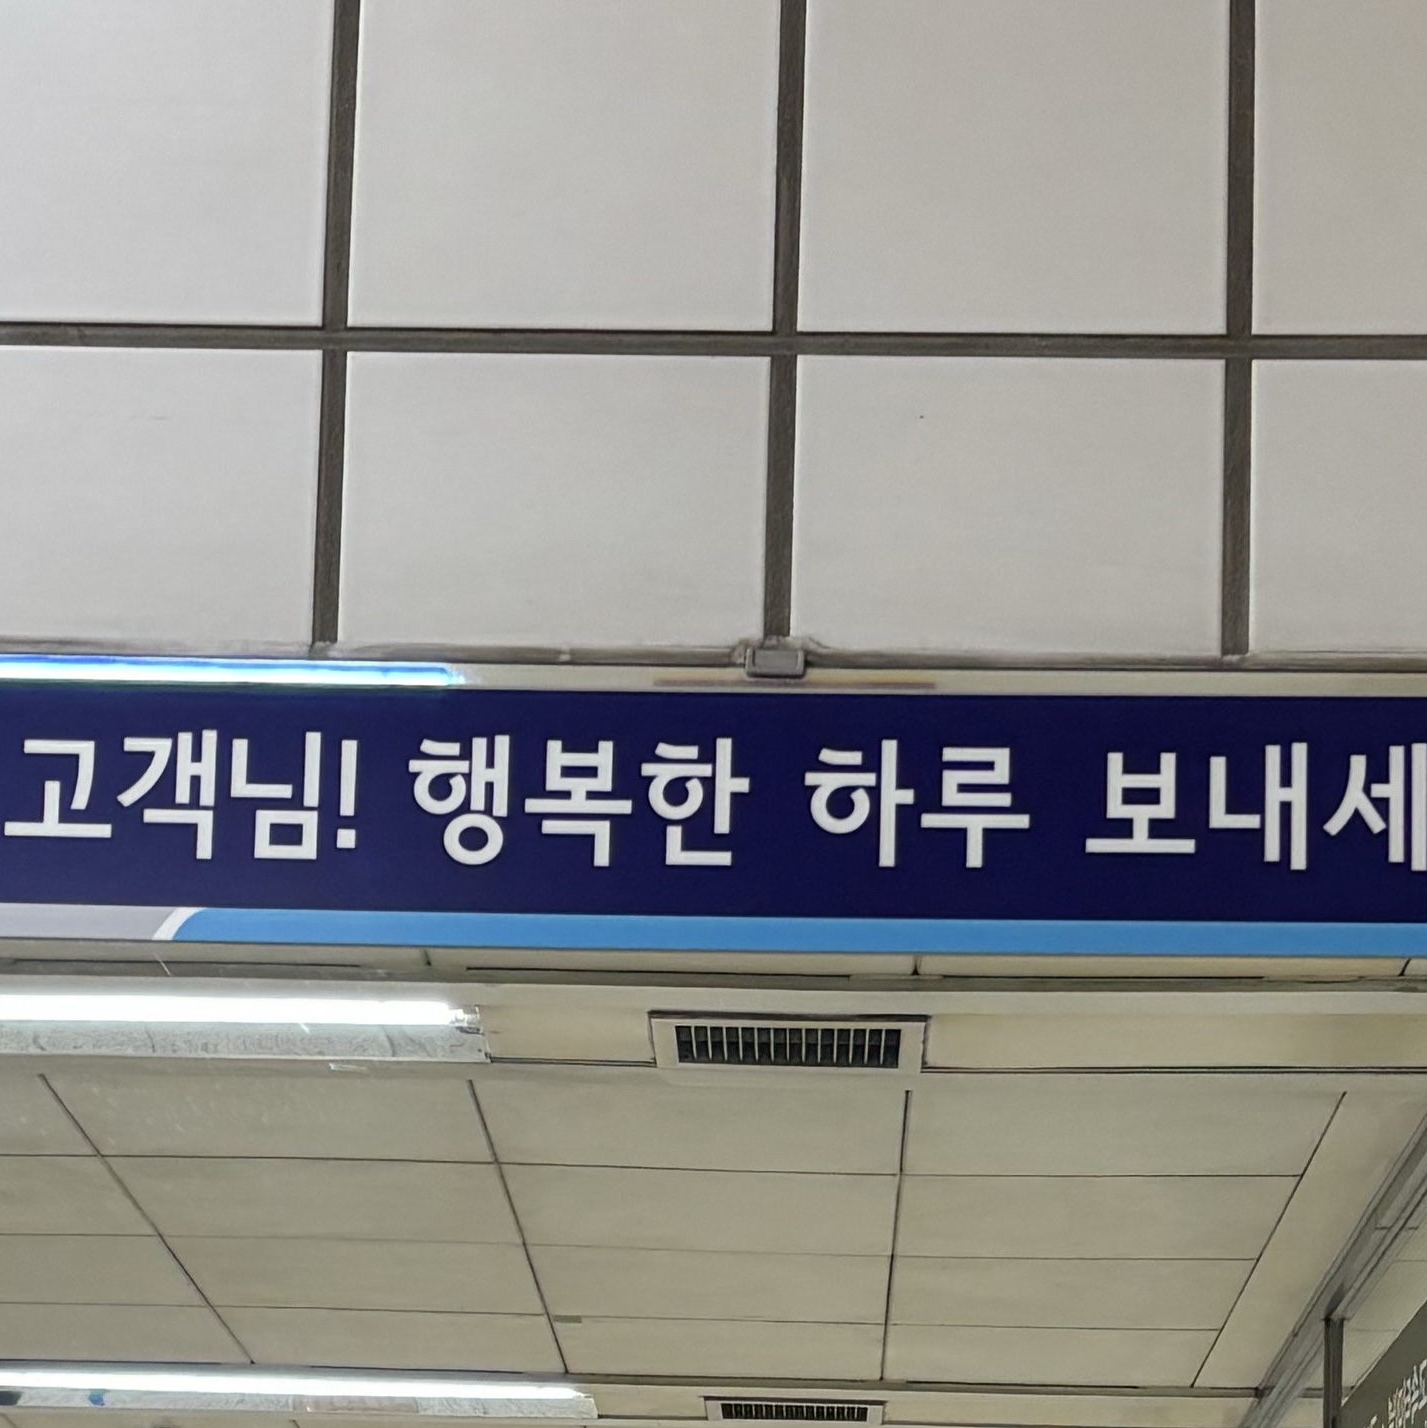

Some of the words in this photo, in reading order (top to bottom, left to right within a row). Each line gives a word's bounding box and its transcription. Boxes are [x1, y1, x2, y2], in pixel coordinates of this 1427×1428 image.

[4, 730, 358, 862] 고객님!
[409, 734, 750, 868] 행복한
[805, 739, 1030, 868] 하루
